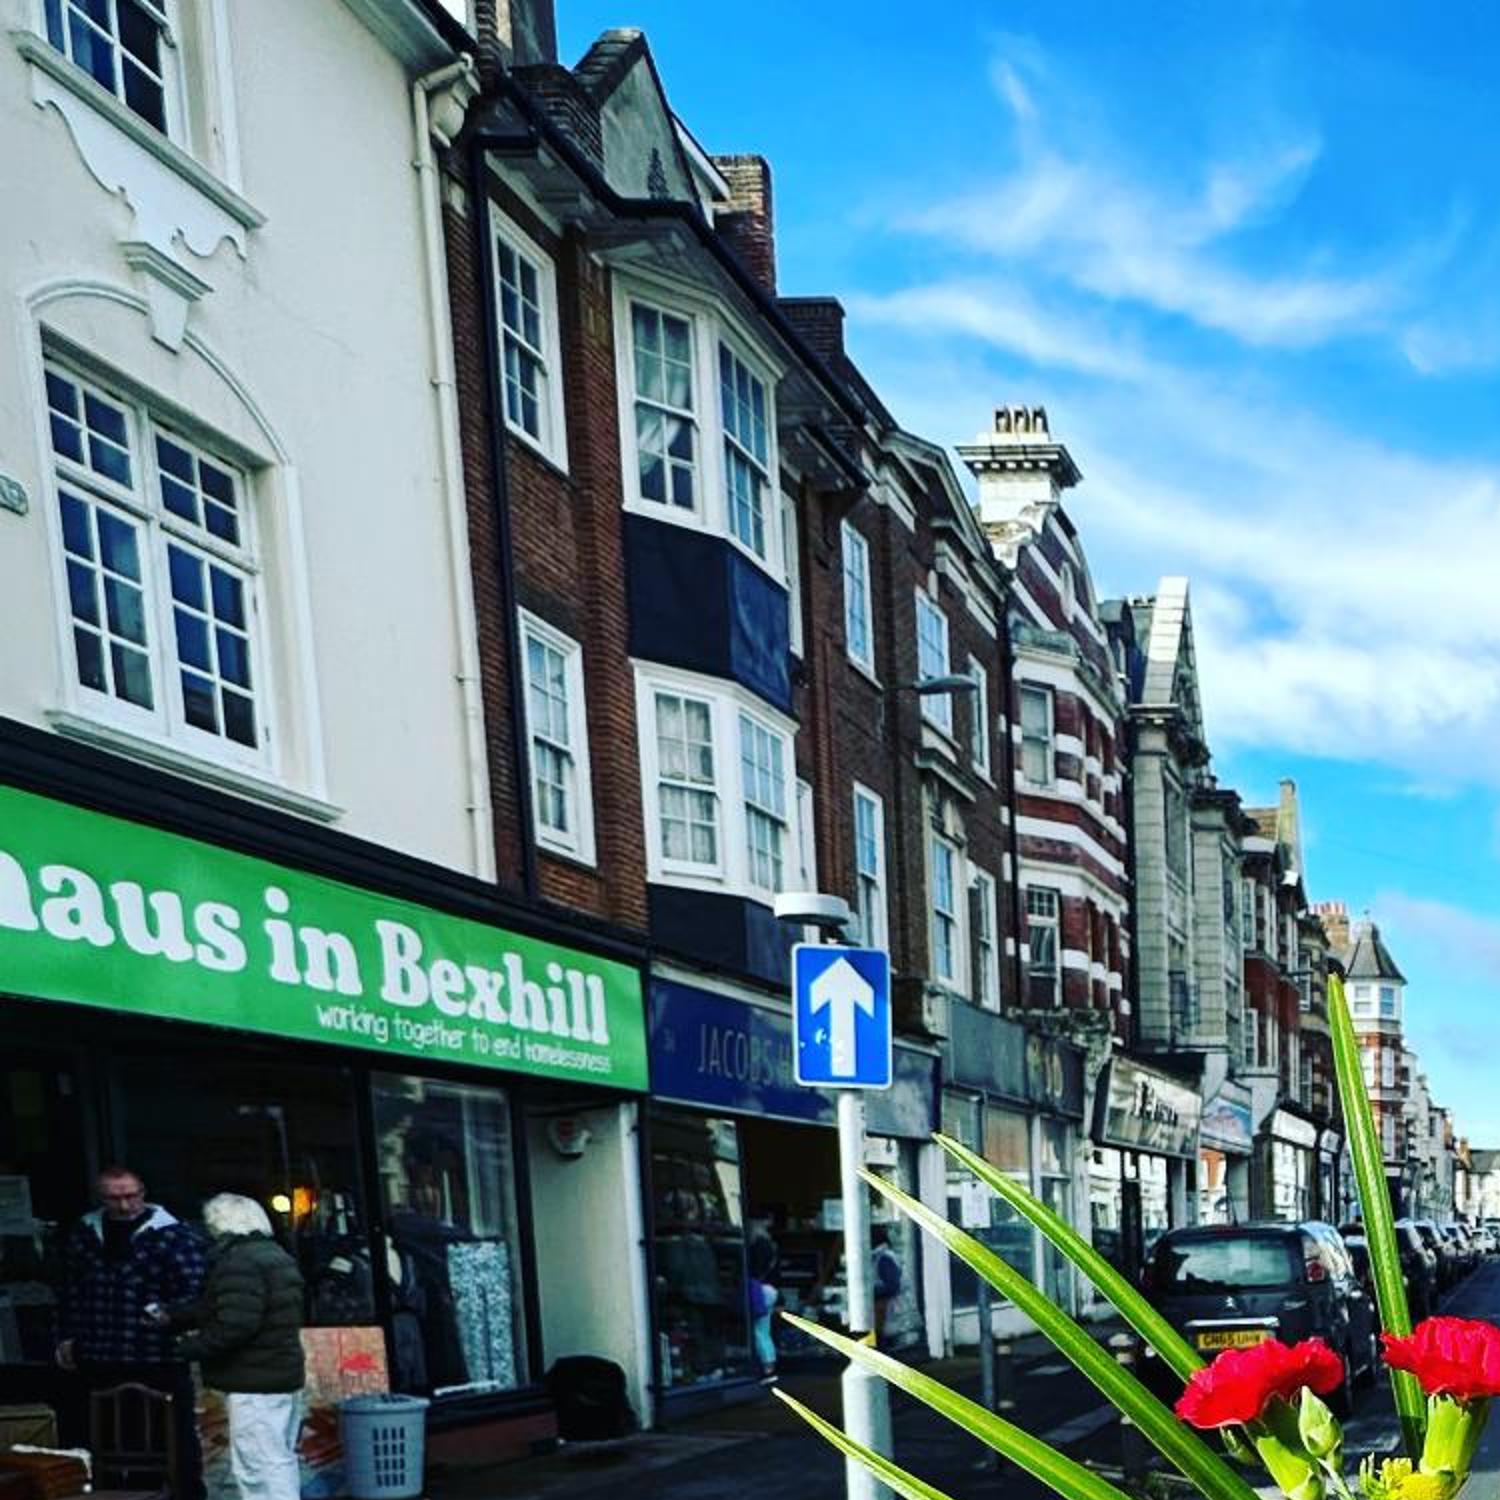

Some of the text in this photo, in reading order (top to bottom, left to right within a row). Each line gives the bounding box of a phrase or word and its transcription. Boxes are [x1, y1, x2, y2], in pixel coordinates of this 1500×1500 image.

[263, 886, 363, 996] in
[375, 918, 610, 1045] Bexhill
[316, 1004, 612, 1074] working together to end homelessness
[697, 1023, 774, 1086] JACOBS
